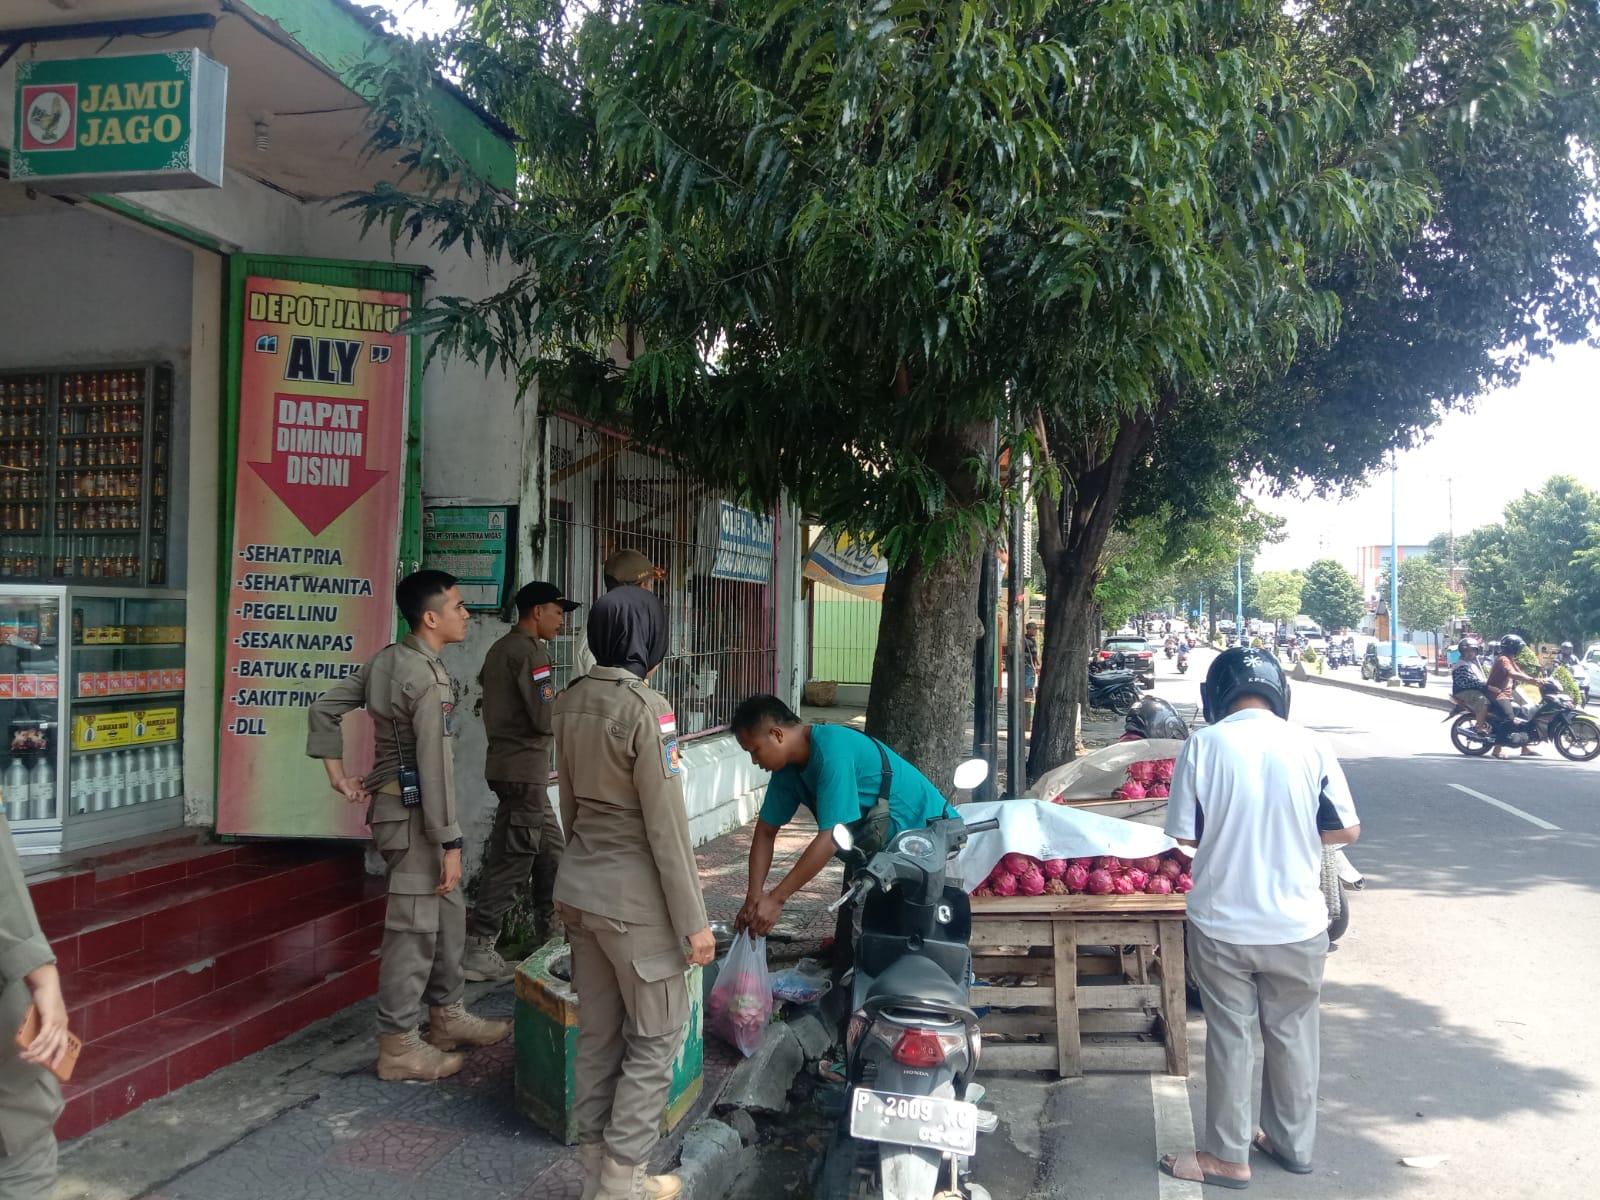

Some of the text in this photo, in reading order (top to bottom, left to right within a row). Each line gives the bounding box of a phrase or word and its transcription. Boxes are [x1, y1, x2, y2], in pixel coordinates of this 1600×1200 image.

[80, 80, 184, 113] JAMU
[79, 114, 182, 147] JAGO
[250, 292, 401, 334] DEPOT JAMU
[278, 400, 363, 429] DAPAT
[276, 427, 363, 457] DIMINUM
[286, 455, 350, 488] DISINI
[303, 548, 343, 566] PRIA
[302, 576, 373, 597] WANITA
[299, 605, 338, 623] LINU
[296, 634, 354, 652] NAPAS
[300, 662, 311, 679] &
[903, 1069, 929, 1077] HONDA
[857, 1092, 870, 1113] P
[884, 1096, 932, 1122] 2009
